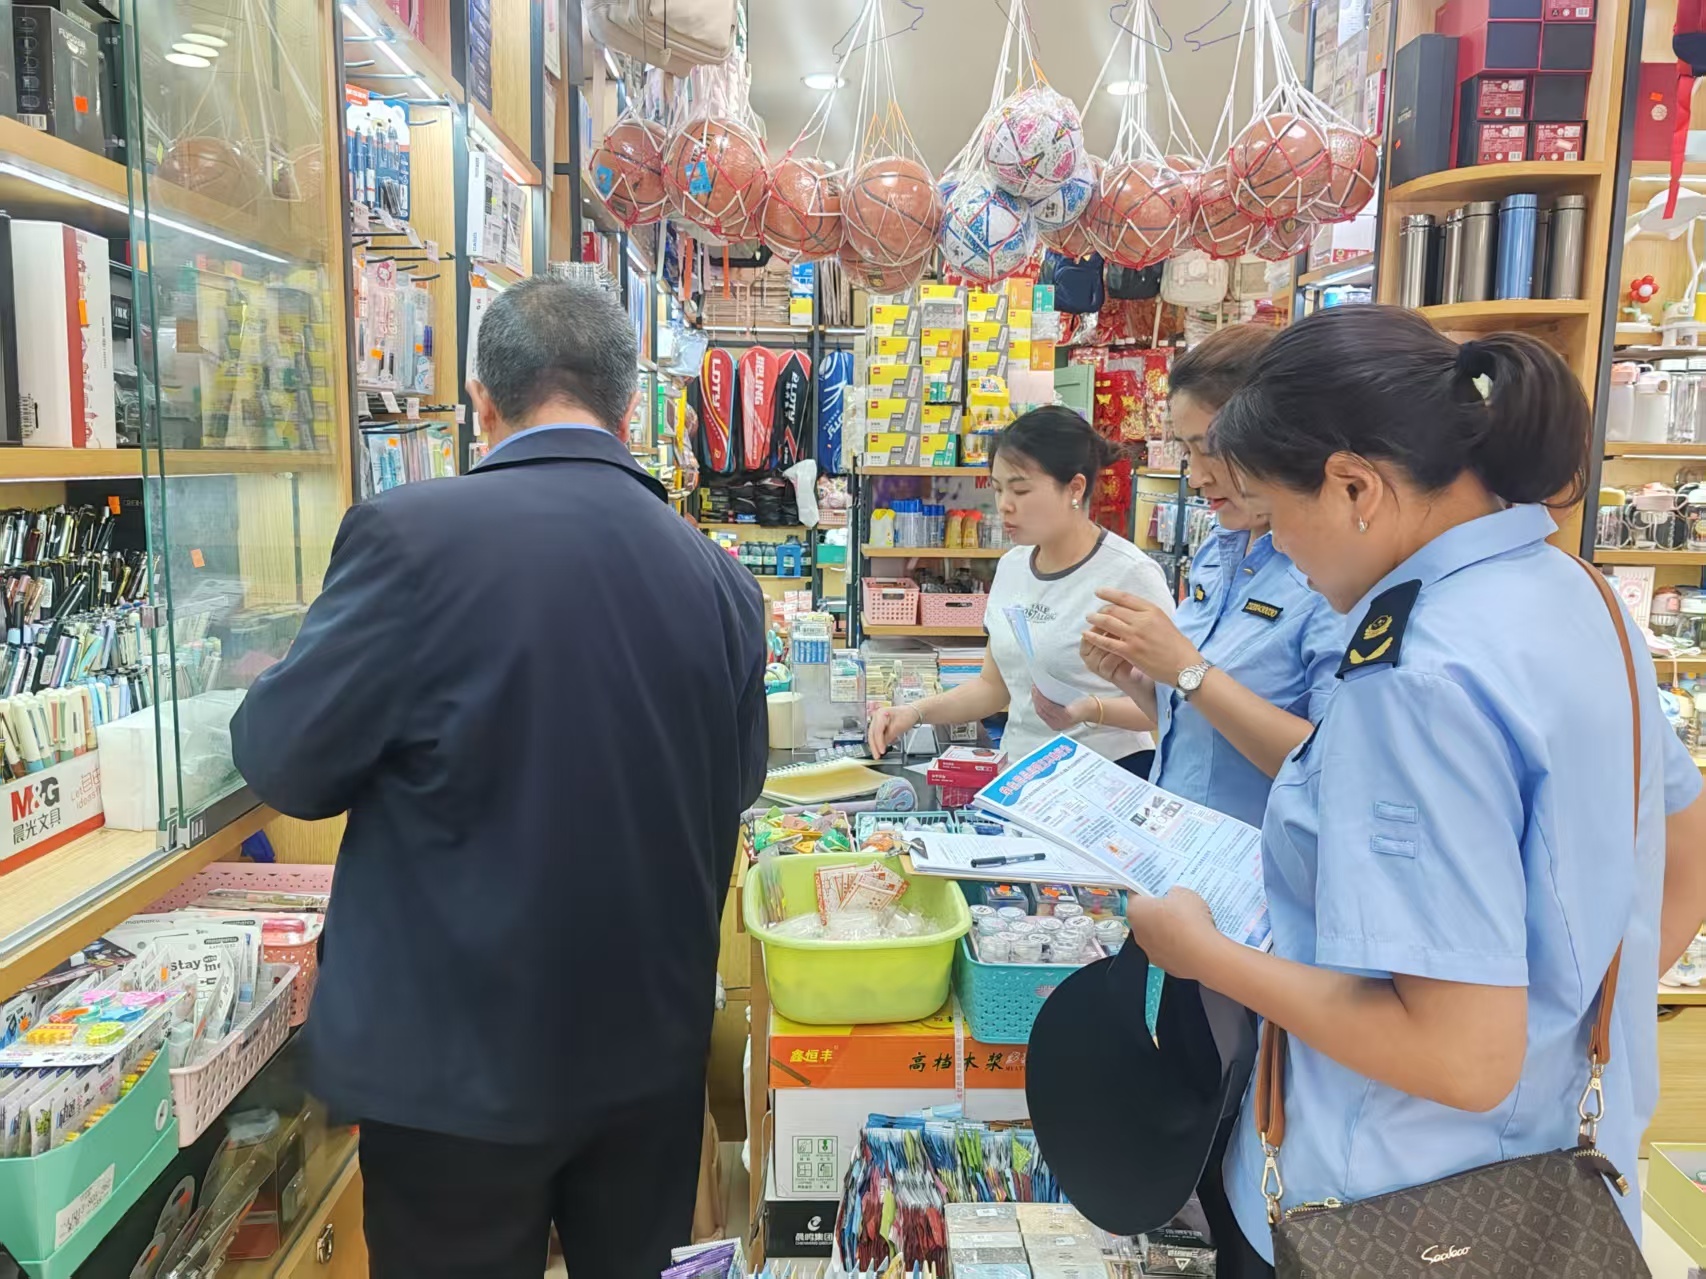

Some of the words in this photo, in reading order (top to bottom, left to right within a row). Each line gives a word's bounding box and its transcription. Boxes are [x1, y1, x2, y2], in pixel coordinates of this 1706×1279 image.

[115, 306, 128, 319] INK
[11, 777, 60, 822] M&G
[13, 807, 61, 845] 晨光文具
[170, 959, 201, 972] stay
[789, 1049, 833, 1063] 鑫恒丰
[908, 1051, 1004, 1072] 高档木浆
